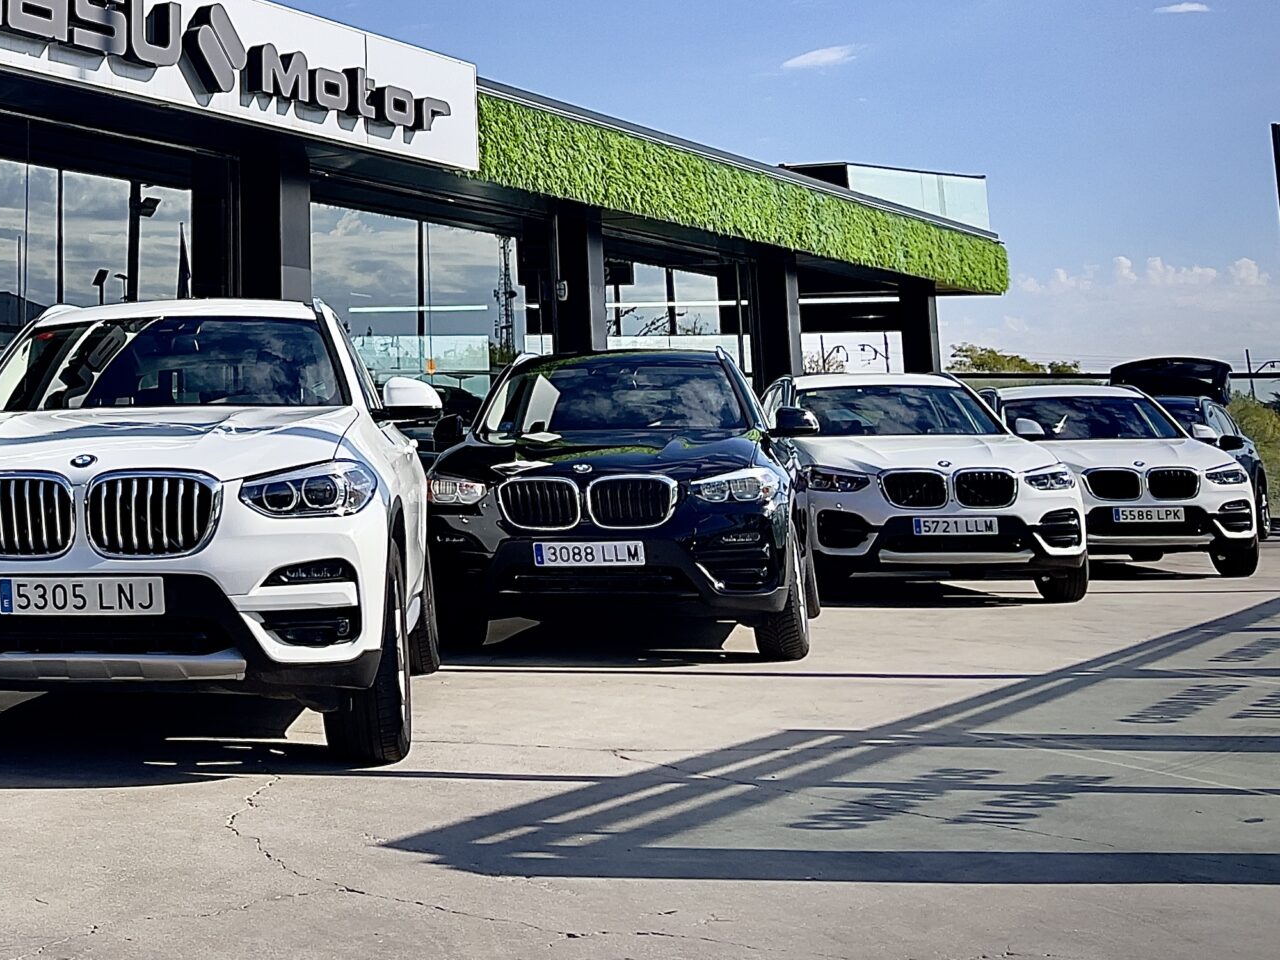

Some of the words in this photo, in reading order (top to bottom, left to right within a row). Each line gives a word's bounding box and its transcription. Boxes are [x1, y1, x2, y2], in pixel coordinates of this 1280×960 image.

[247, 43, 452, 131] Motor
[1121, 510, 1153, 521] 5586
[1157, 509, 1181, 521] LPK
[923, 520, 959, 533] 5721
[965, 519, 994, 533] LLM
[547, 546, 595, 563] 3088
[601, 544, 640, 563] LLM
[16, 583, 87, 610] 5305
[98, 583, 154, 610] LNJ
